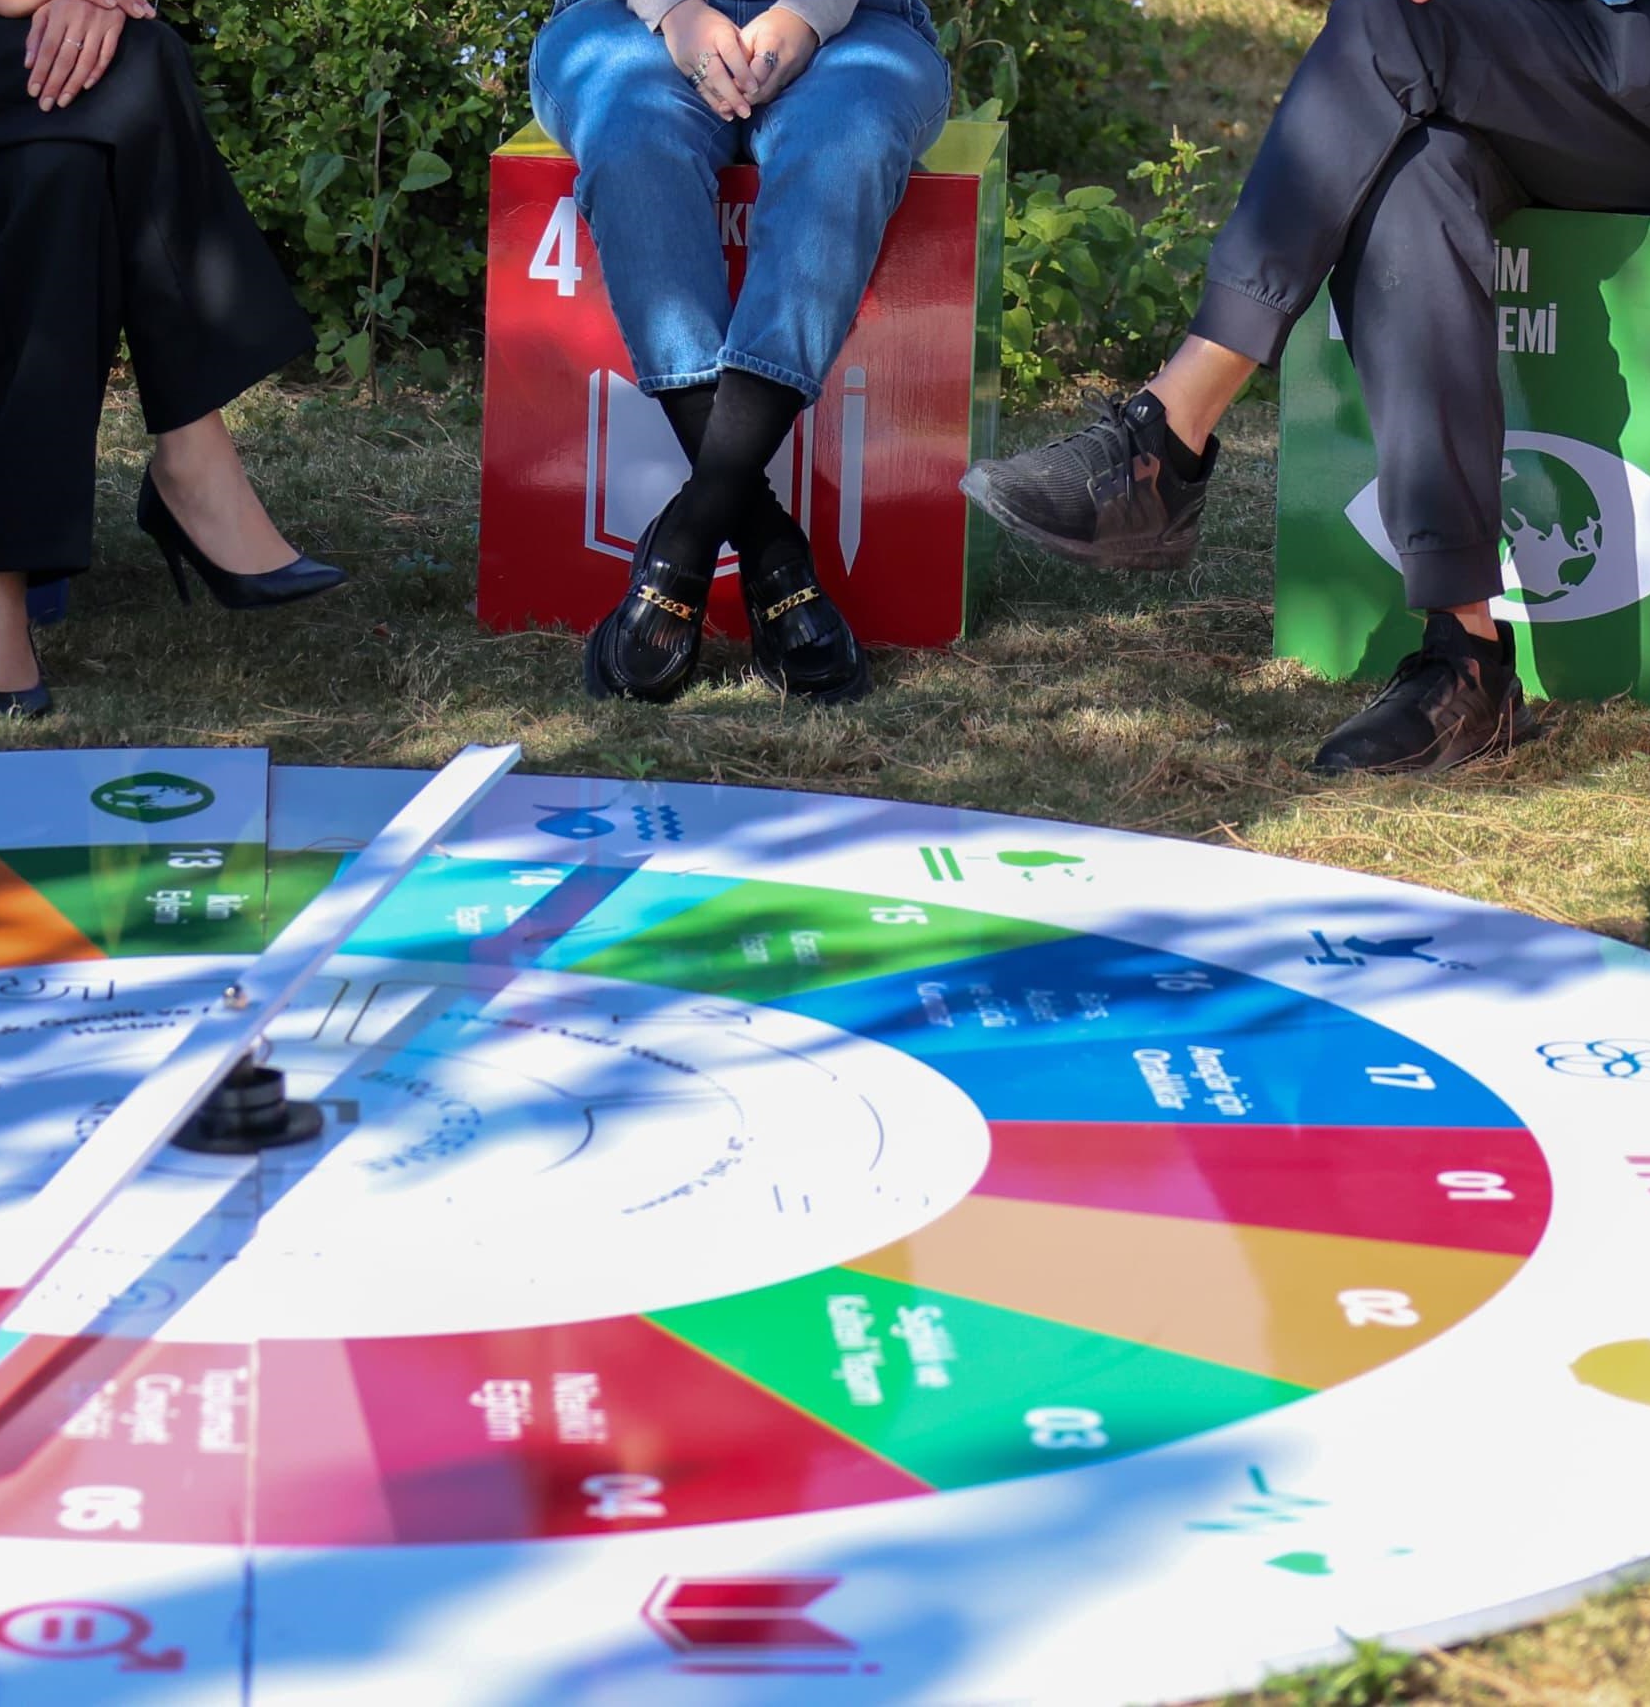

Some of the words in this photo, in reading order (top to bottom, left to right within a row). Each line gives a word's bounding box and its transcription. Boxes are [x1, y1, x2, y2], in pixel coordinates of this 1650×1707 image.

[528, 196, 582, 296] 4
[167, 849, 221, 868] 13
[510, 867, 564, 885] 14
[870, 904, 927, 924] 15
[1152, 970, 1212, 991] 16
[1366, 1063, 1434, 1089] 17
[1438, 1170, 1512, 1200] 01
[1339, 1288, 1417, 1326] 02
[1026, 1406, 1104, 1447] 03
[59, 1485, 140, 1530] 05
[585, 1473, 663, 1517] 04
